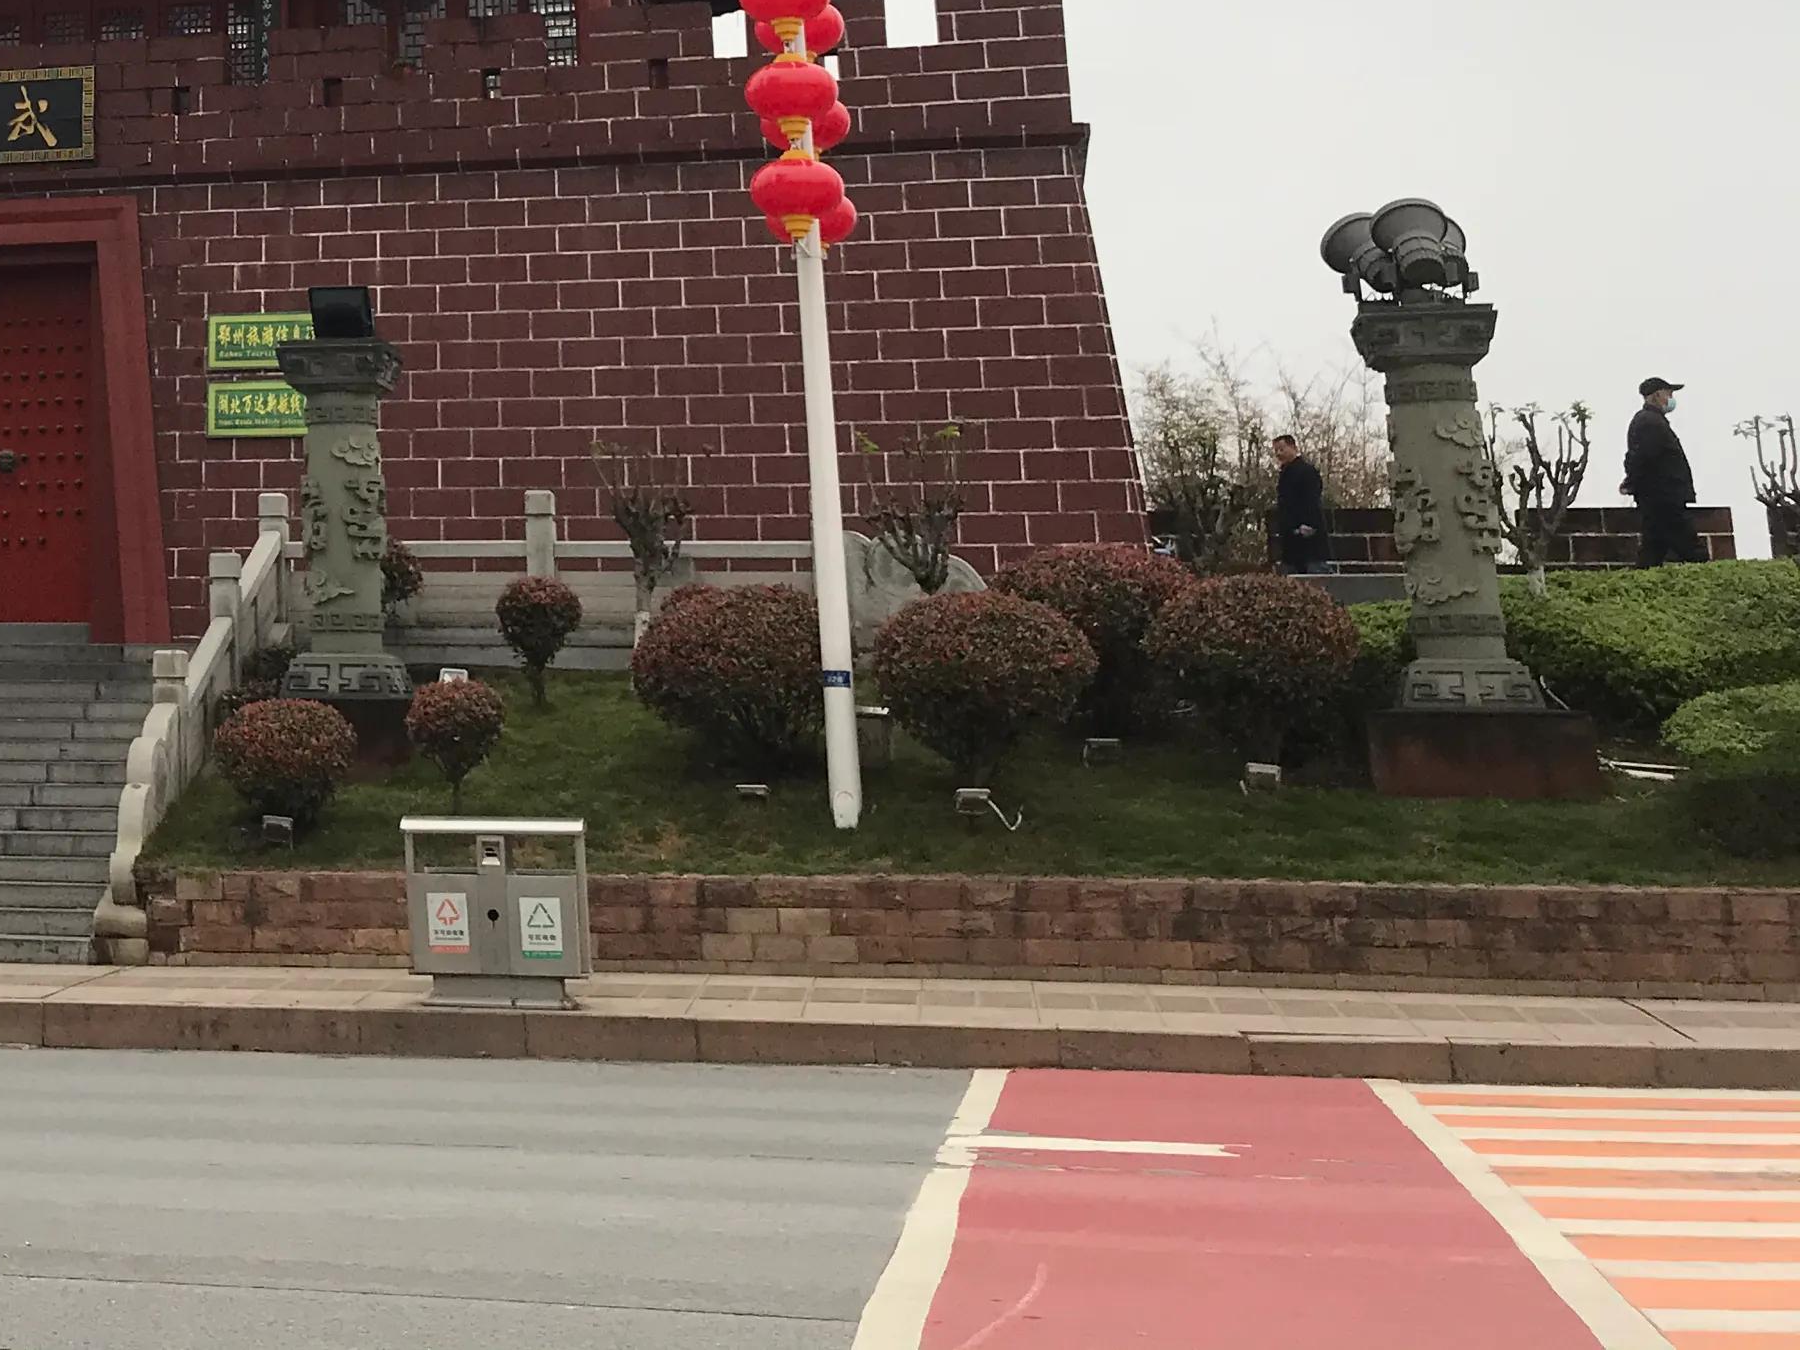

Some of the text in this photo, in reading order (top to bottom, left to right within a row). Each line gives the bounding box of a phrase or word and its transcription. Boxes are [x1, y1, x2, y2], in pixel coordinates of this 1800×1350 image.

[218, 392, 307, 416] 湖北万达新航线
